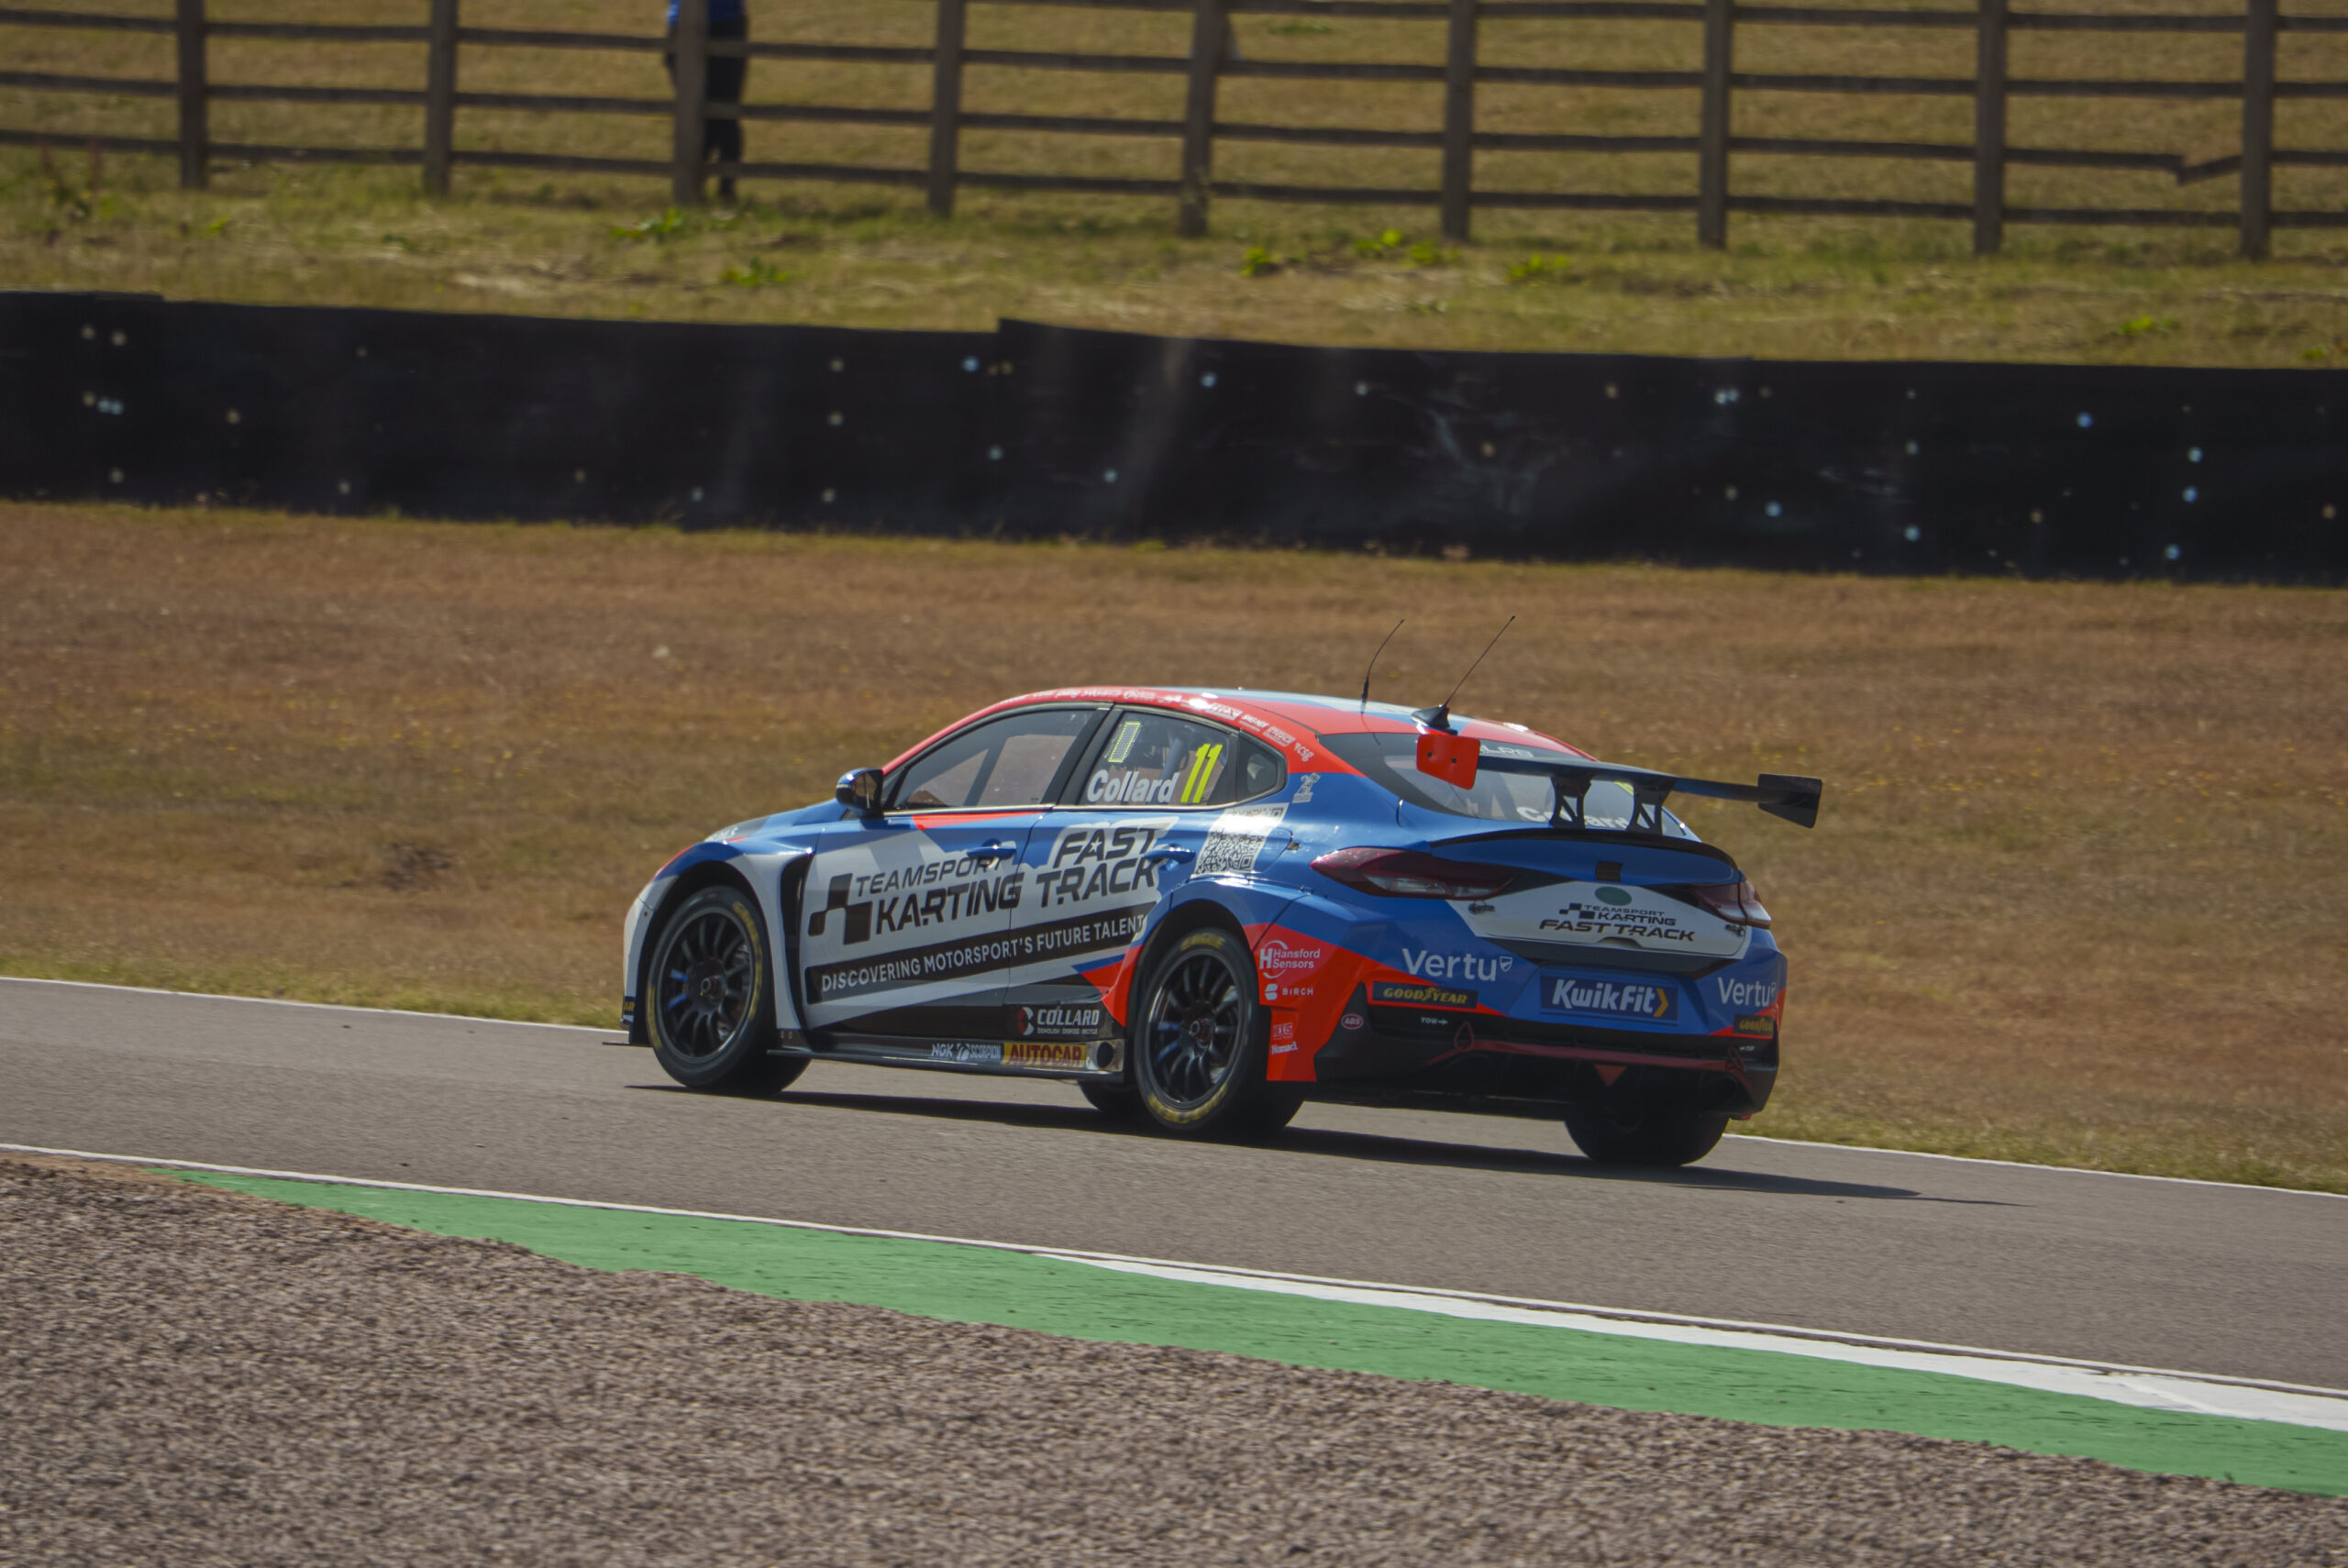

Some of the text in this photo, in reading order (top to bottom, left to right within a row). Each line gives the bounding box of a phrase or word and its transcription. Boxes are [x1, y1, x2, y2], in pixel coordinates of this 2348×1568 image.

[1087, 743, 1224, 804] Collard 11
[1053, 827, 1161, 869] FAST
[1036, 857, 1155, 908] TRACK
[876, 872, 1024, 934] KARTING
[1584, 905, 1665, 917] TEAMSPORT
[1597, 912, 1677, 926] KARTING
[1614, 923, 1695, 942] TRACK
[822, 957, 921, 992] DISCOVERING
[1036, 924, 1091, 953] FUTURE
[1093, 913, 1146, 941] TALENT
[1273, 948, 1321, 959] Hansford
[1273, 958, 1314, 969] Sensors
[1401, 948, 1497, 981] Vertu
[1282, 988, 1313, 996] BIRCH
[1717, 977, 1770, 1007] Vertu
[1037, 1010, 1100, 1026] COLLARD
[931, 1043, 954, 1057] NGK
[1011, 1044, 1083, 1066] AUTOCAR
